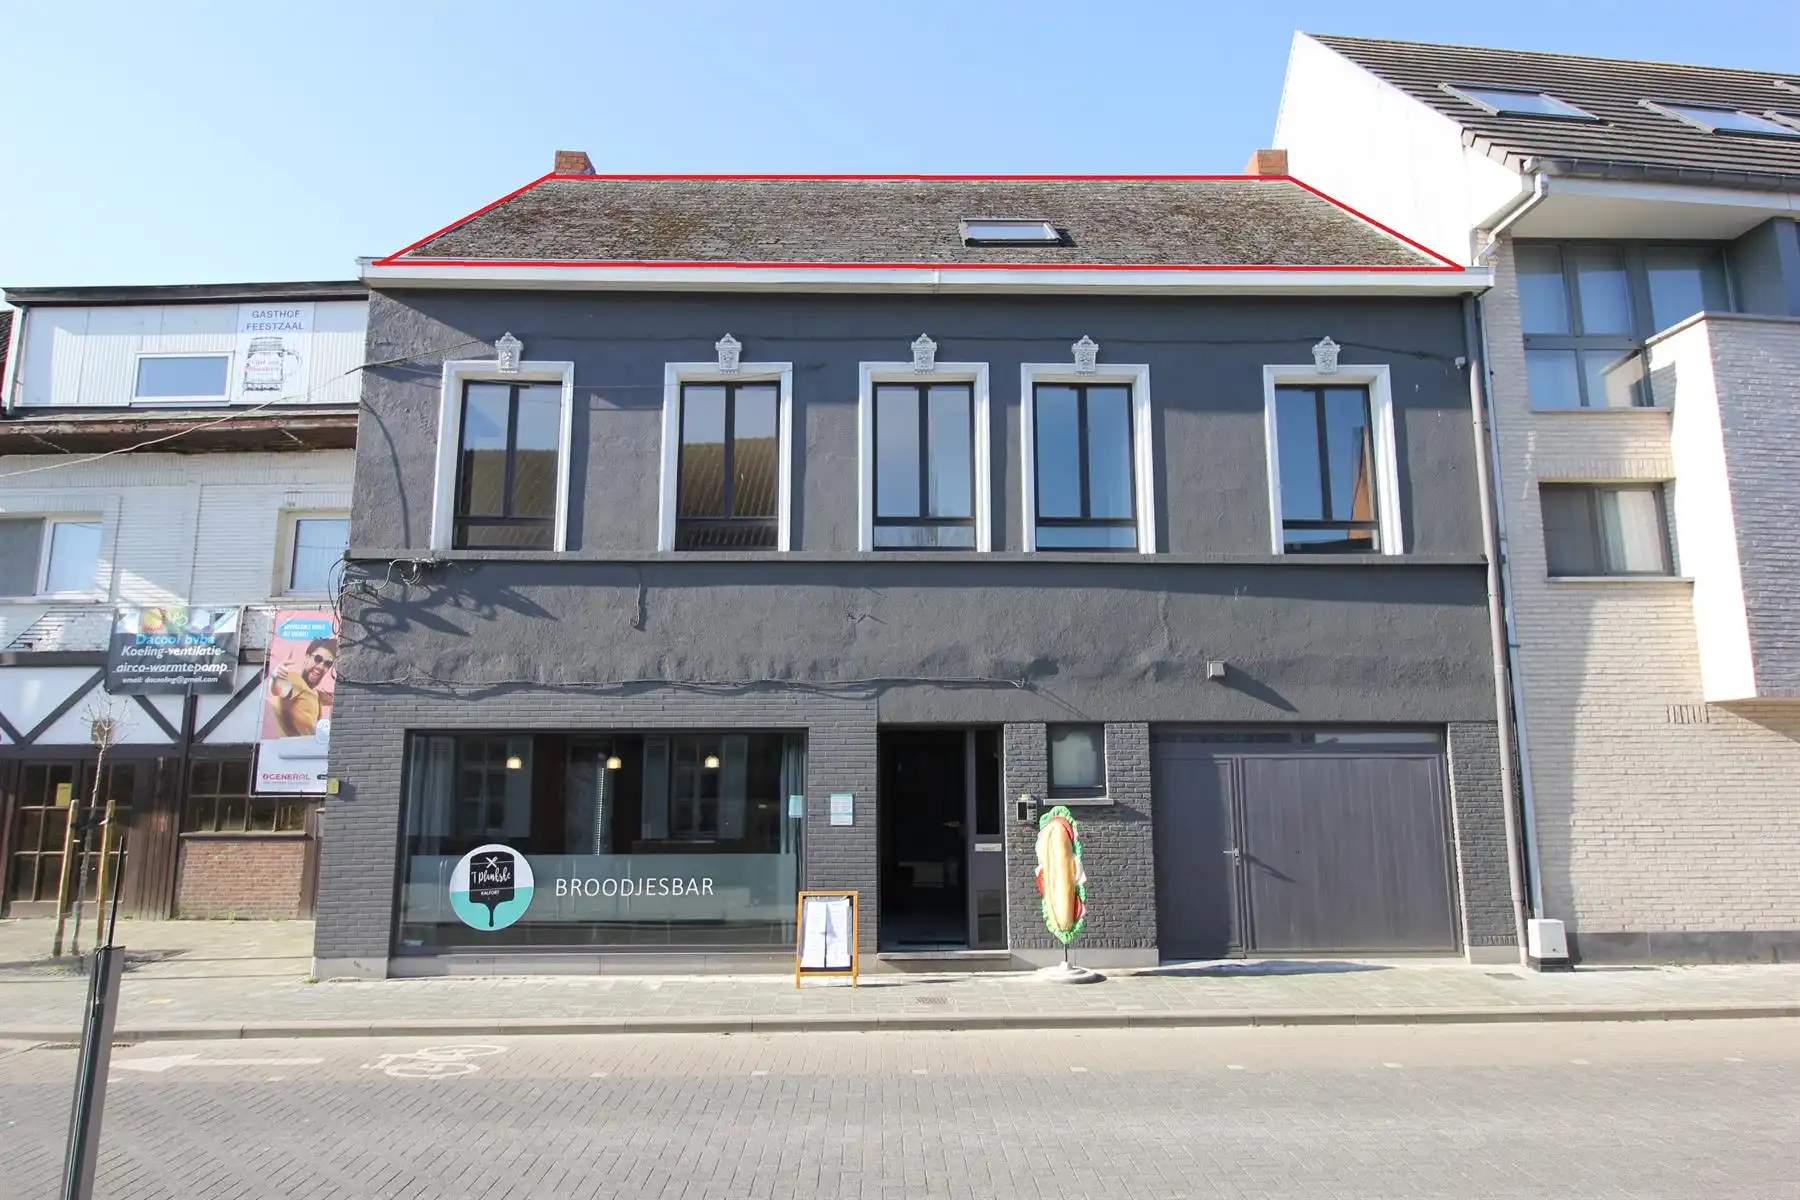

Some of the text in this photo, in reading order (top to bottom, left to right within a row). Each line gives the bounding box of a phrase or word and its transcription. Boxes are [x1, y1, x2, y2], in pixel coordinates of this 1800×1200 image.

[252, 310, 301, 319] GASTHOF
[246, 322, 304, 331] FEESTZAAL
[121, 645, 226, 659] Koeling-ventilatie-
[555, 877, 714, 897] BROODJESBAR
